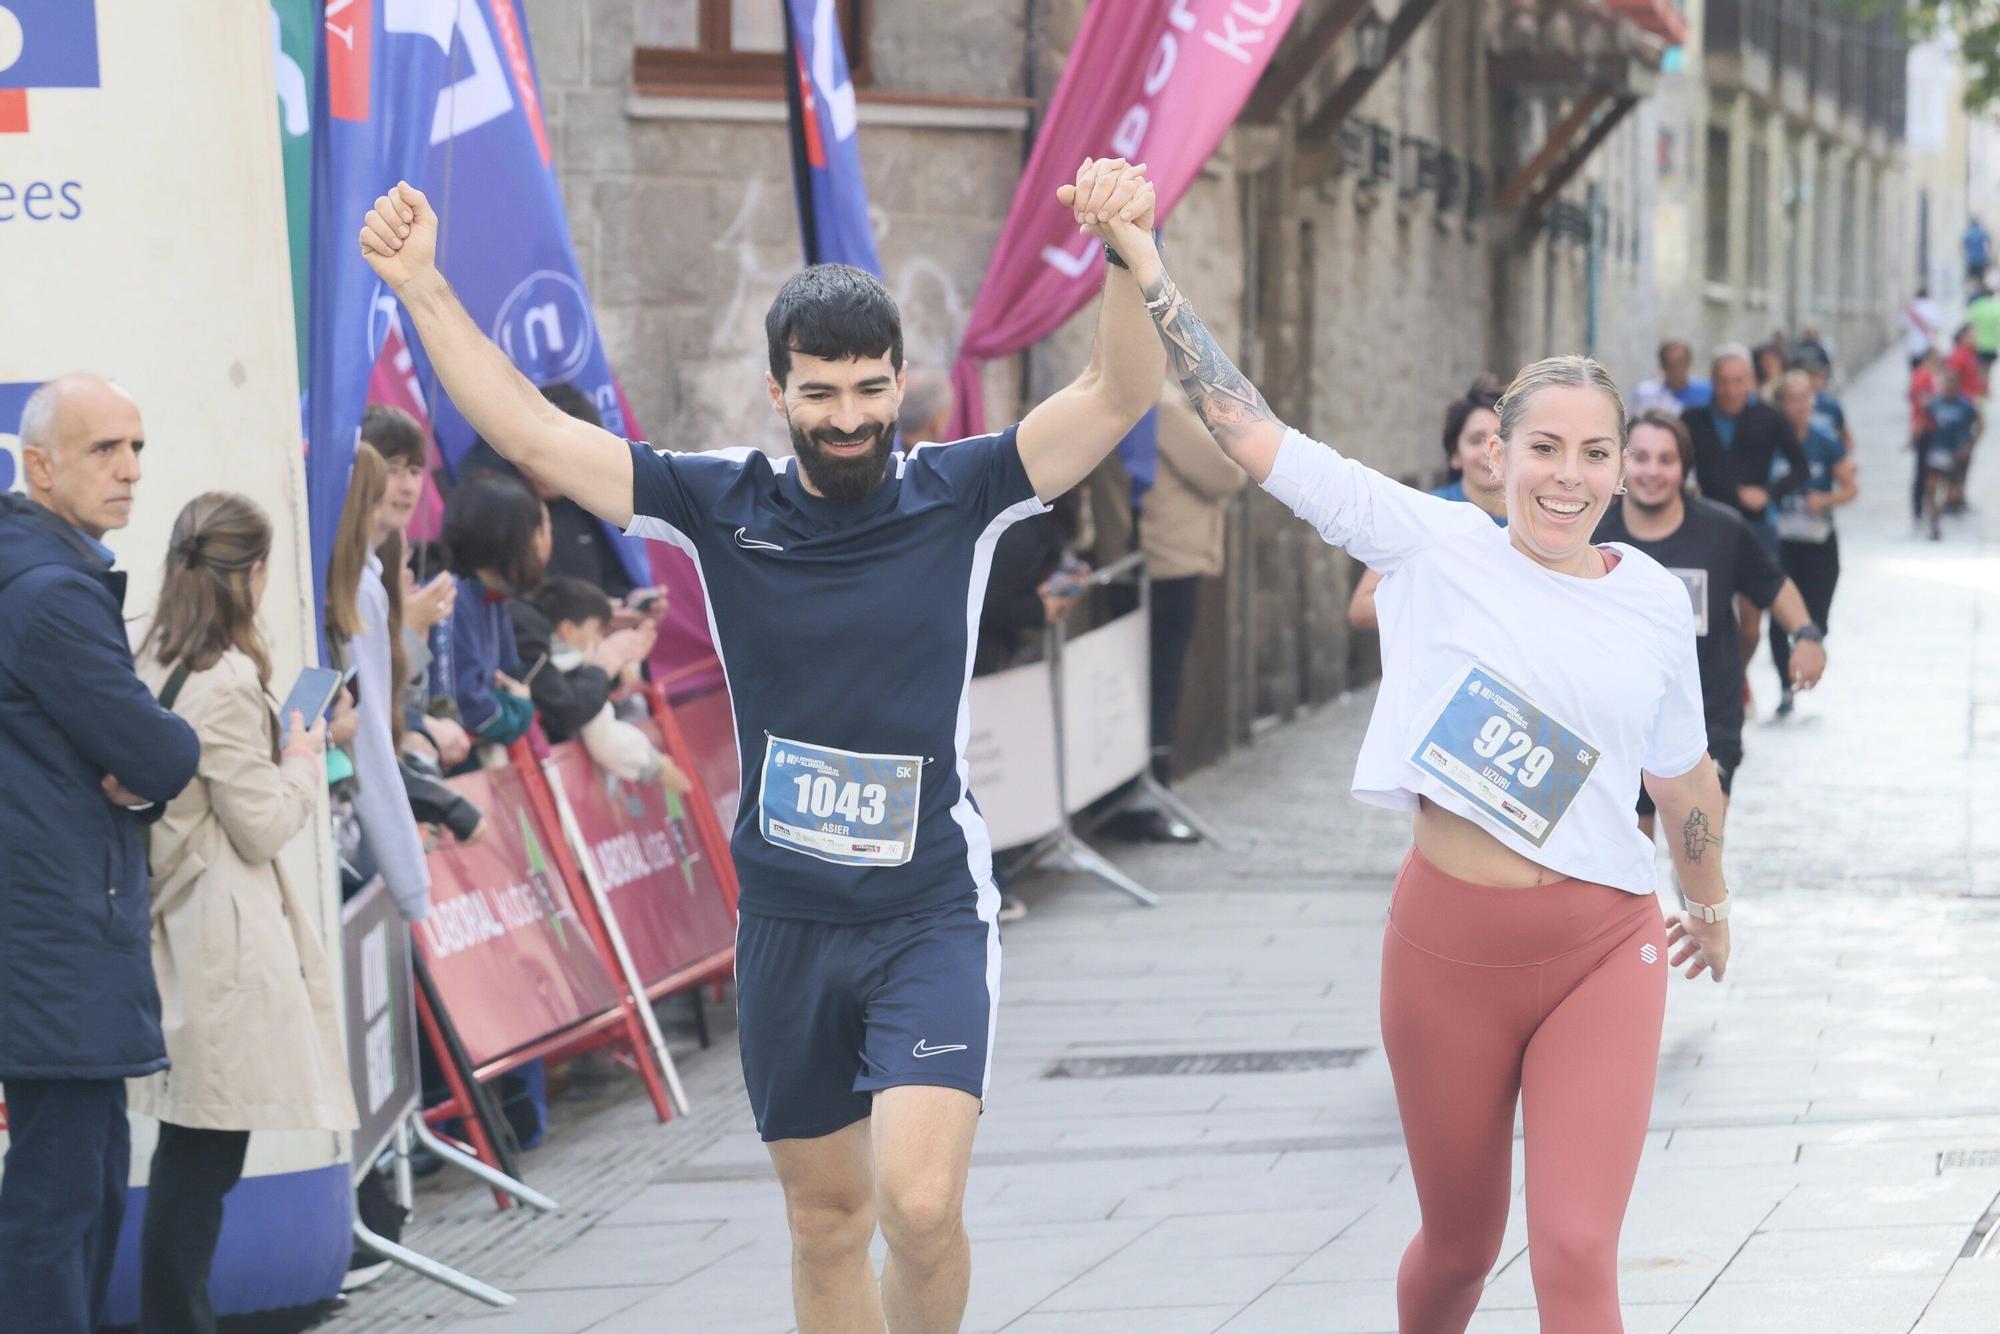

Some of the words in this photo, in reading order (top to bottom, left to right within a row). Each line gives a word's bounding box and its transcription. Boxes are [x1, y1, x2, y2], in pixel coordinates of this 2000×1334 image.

[1472, 715, 1555, 788] 929
[1576, 749, 1593, 766] 5K
[896, 766, 912, 779] 5K
[1482, 766, 1511, 791] UZURI
[793, 773, 887, 825] 1043
[821, 822, 850, 836] ASIER
